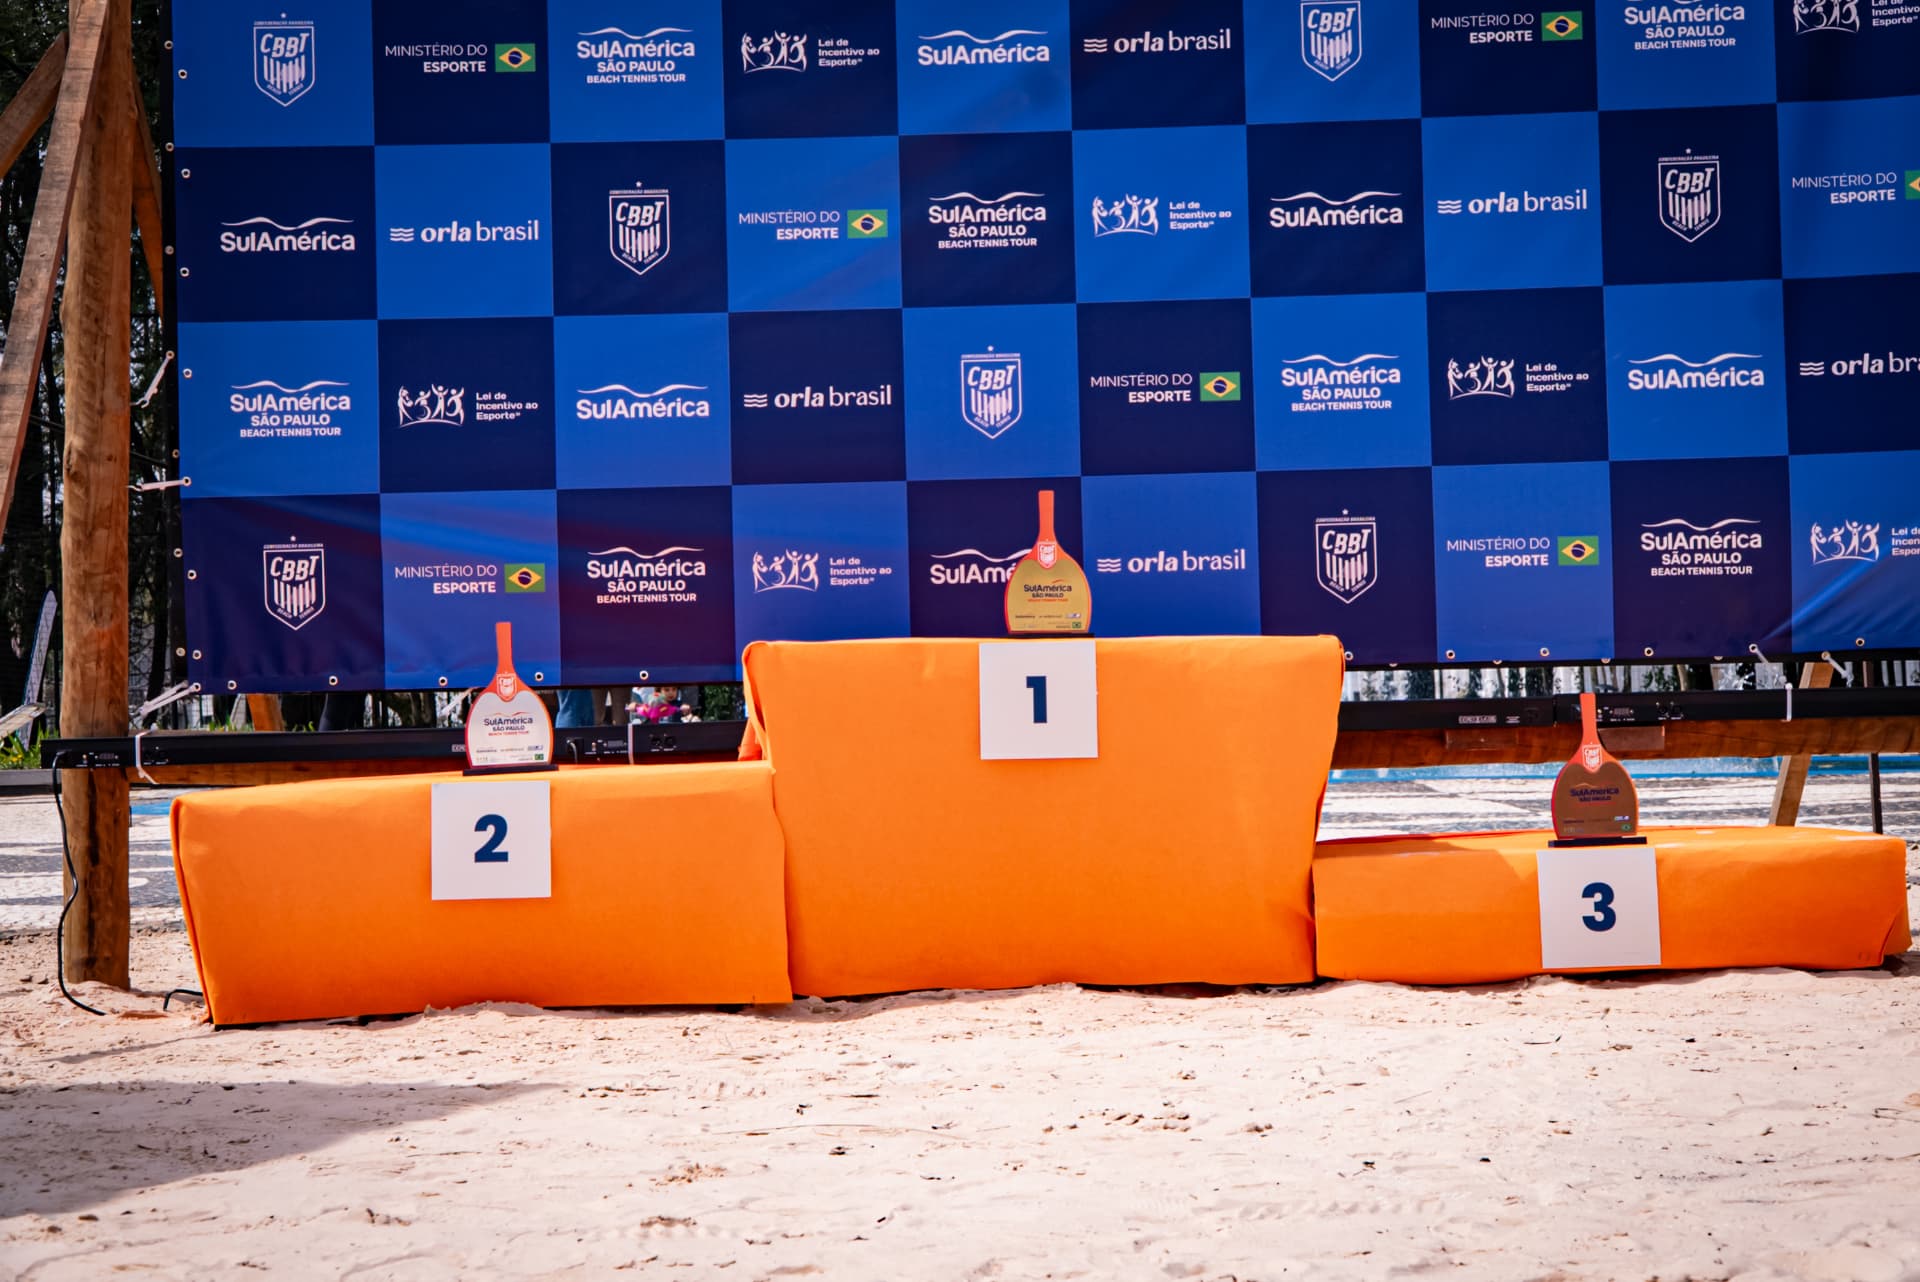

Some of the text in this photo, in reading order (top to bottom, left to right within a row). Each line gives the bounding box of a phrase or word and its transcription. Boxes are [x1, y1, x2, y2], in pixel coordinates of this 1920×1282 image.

[1624, 4, 1744, 25] SulAmérica
[1872, 6, 1920, 16] Incentivo
[1307, 7, 1356, 33] CBBT
[1432, 13, 1534, 28] MINISTÉRIO DO
[1470, 30, 1533, 44] ESPORTE
[1645, 25, 1725, 39] SÃO PAULO
[260, 33, 310, 58] CBBT
[818, 39, 834, 47] Lei
[1114, 28, 1230, 53] orla brasil
[1635, 38, 1736, 50] BEACH TENNIS TOUR
[385, 44, 487, 56] MINISTÉRIO DO
[577, 40, 695, 58] SulAmérica
[818, 48, 865, 56] Incentivo
[918, 43, 1050, 65] SulAmérica
[424, 61, 486, 72] ESPORTE
[597, 59, 675, 73] SÃO PAULO
[587, 74, 686, 83] BEACH TENNIS TOUR
[1664, 167, 1715, 194] CBBT
[1792, 172, 1897, 188] MINISTÉRIO DO
[1468, 189, 1587, 214] orla brasil
[1830, 189, 1896, 204] ESPORTE
[1169, 201, 1200, 210] Lei de
[615, 201, 664, 227] CBBT
[739, 210, 840, 224] MINISTÉRIO DO
[929, 204, 1046, 223] SulAmérica
[1169, 211, 1217, 220] Incentivo
[1270, 205, 1403, 228] SulAmérica
[421, 220, 539, 242] orla brasil
[776, 227, 839, 240] ESPORTE
[949, 224, 1027, 238] SÃO PAULO
[221, 231, 355, 252] SulAmérica
[938, 238, 1037, 249] BEACH TENNIS TOUR
[1526, 363, 1557, 372] Lei de
[1831, 353, 1884, 375] orla
[967, 365, 1016, 390] CBBT
[1091, 373, 1192, 387] MINISTÉRIO DO
[1281, 366, 1400, 386] SulAmérica
[1526, 373, 1573, 382] Incentivo
[1628, 367, 1764, 390] SulAmérica
[476, 392, 507, 401] Lei de
[774, 384, 891, 408] orla brasil
[1129, 390, 1191, 403] ESPORTE
[1302, 386, 1381, 400] SÃO PAULO
[230, 393, 351, 412] SulAmérica
[476, 402, 523, 410] Incentivo
[576, 398, 709, 419] SulAmérica
[1292, 400, 1392, 411] BEACH TENNIS TOUR
[251, 412, 330, 426] SÃO PAULO
[240, 427, 341, 437] BEACH TENNIS TOUR
[1892, 528, 1908, 536] Lei
[1322, 528, 1372, 555] CBBT
[1447, 537, 1550, 551] MINISTÉRIO DO
[1641, 531, 1762, 551] SulAmérica
[830, 557, 860, 566] Lei de
[1127, 549, 1245, 573] orla brasil
[1485, 554, 1549, 567] ESPORTE
[1662, 551, 1742, 565] SÃO PAULO
[270, 555, 320, 582] CBBT
[395, 563, 497, 578] MINISTÉRIO DO
[587, 559, 706, 578] SulAmérica
[830, 567, 877, 576] Incentivo
[1651, 566, 1752, 576] BEACH TENNIS TOUR
[433, 581, 496, 594] ESPORTE
[608, 578, 686, 593] SÃO PAULO
[1023, 583, 1072, 592] SulAmérica
[597, 593, 696, 604] BEACH TENNIS TOUR
[1026, 676, 1047, 723] 1
[474, 814, 508, 862] 2
[1581, 882, 1616, 931] 3
